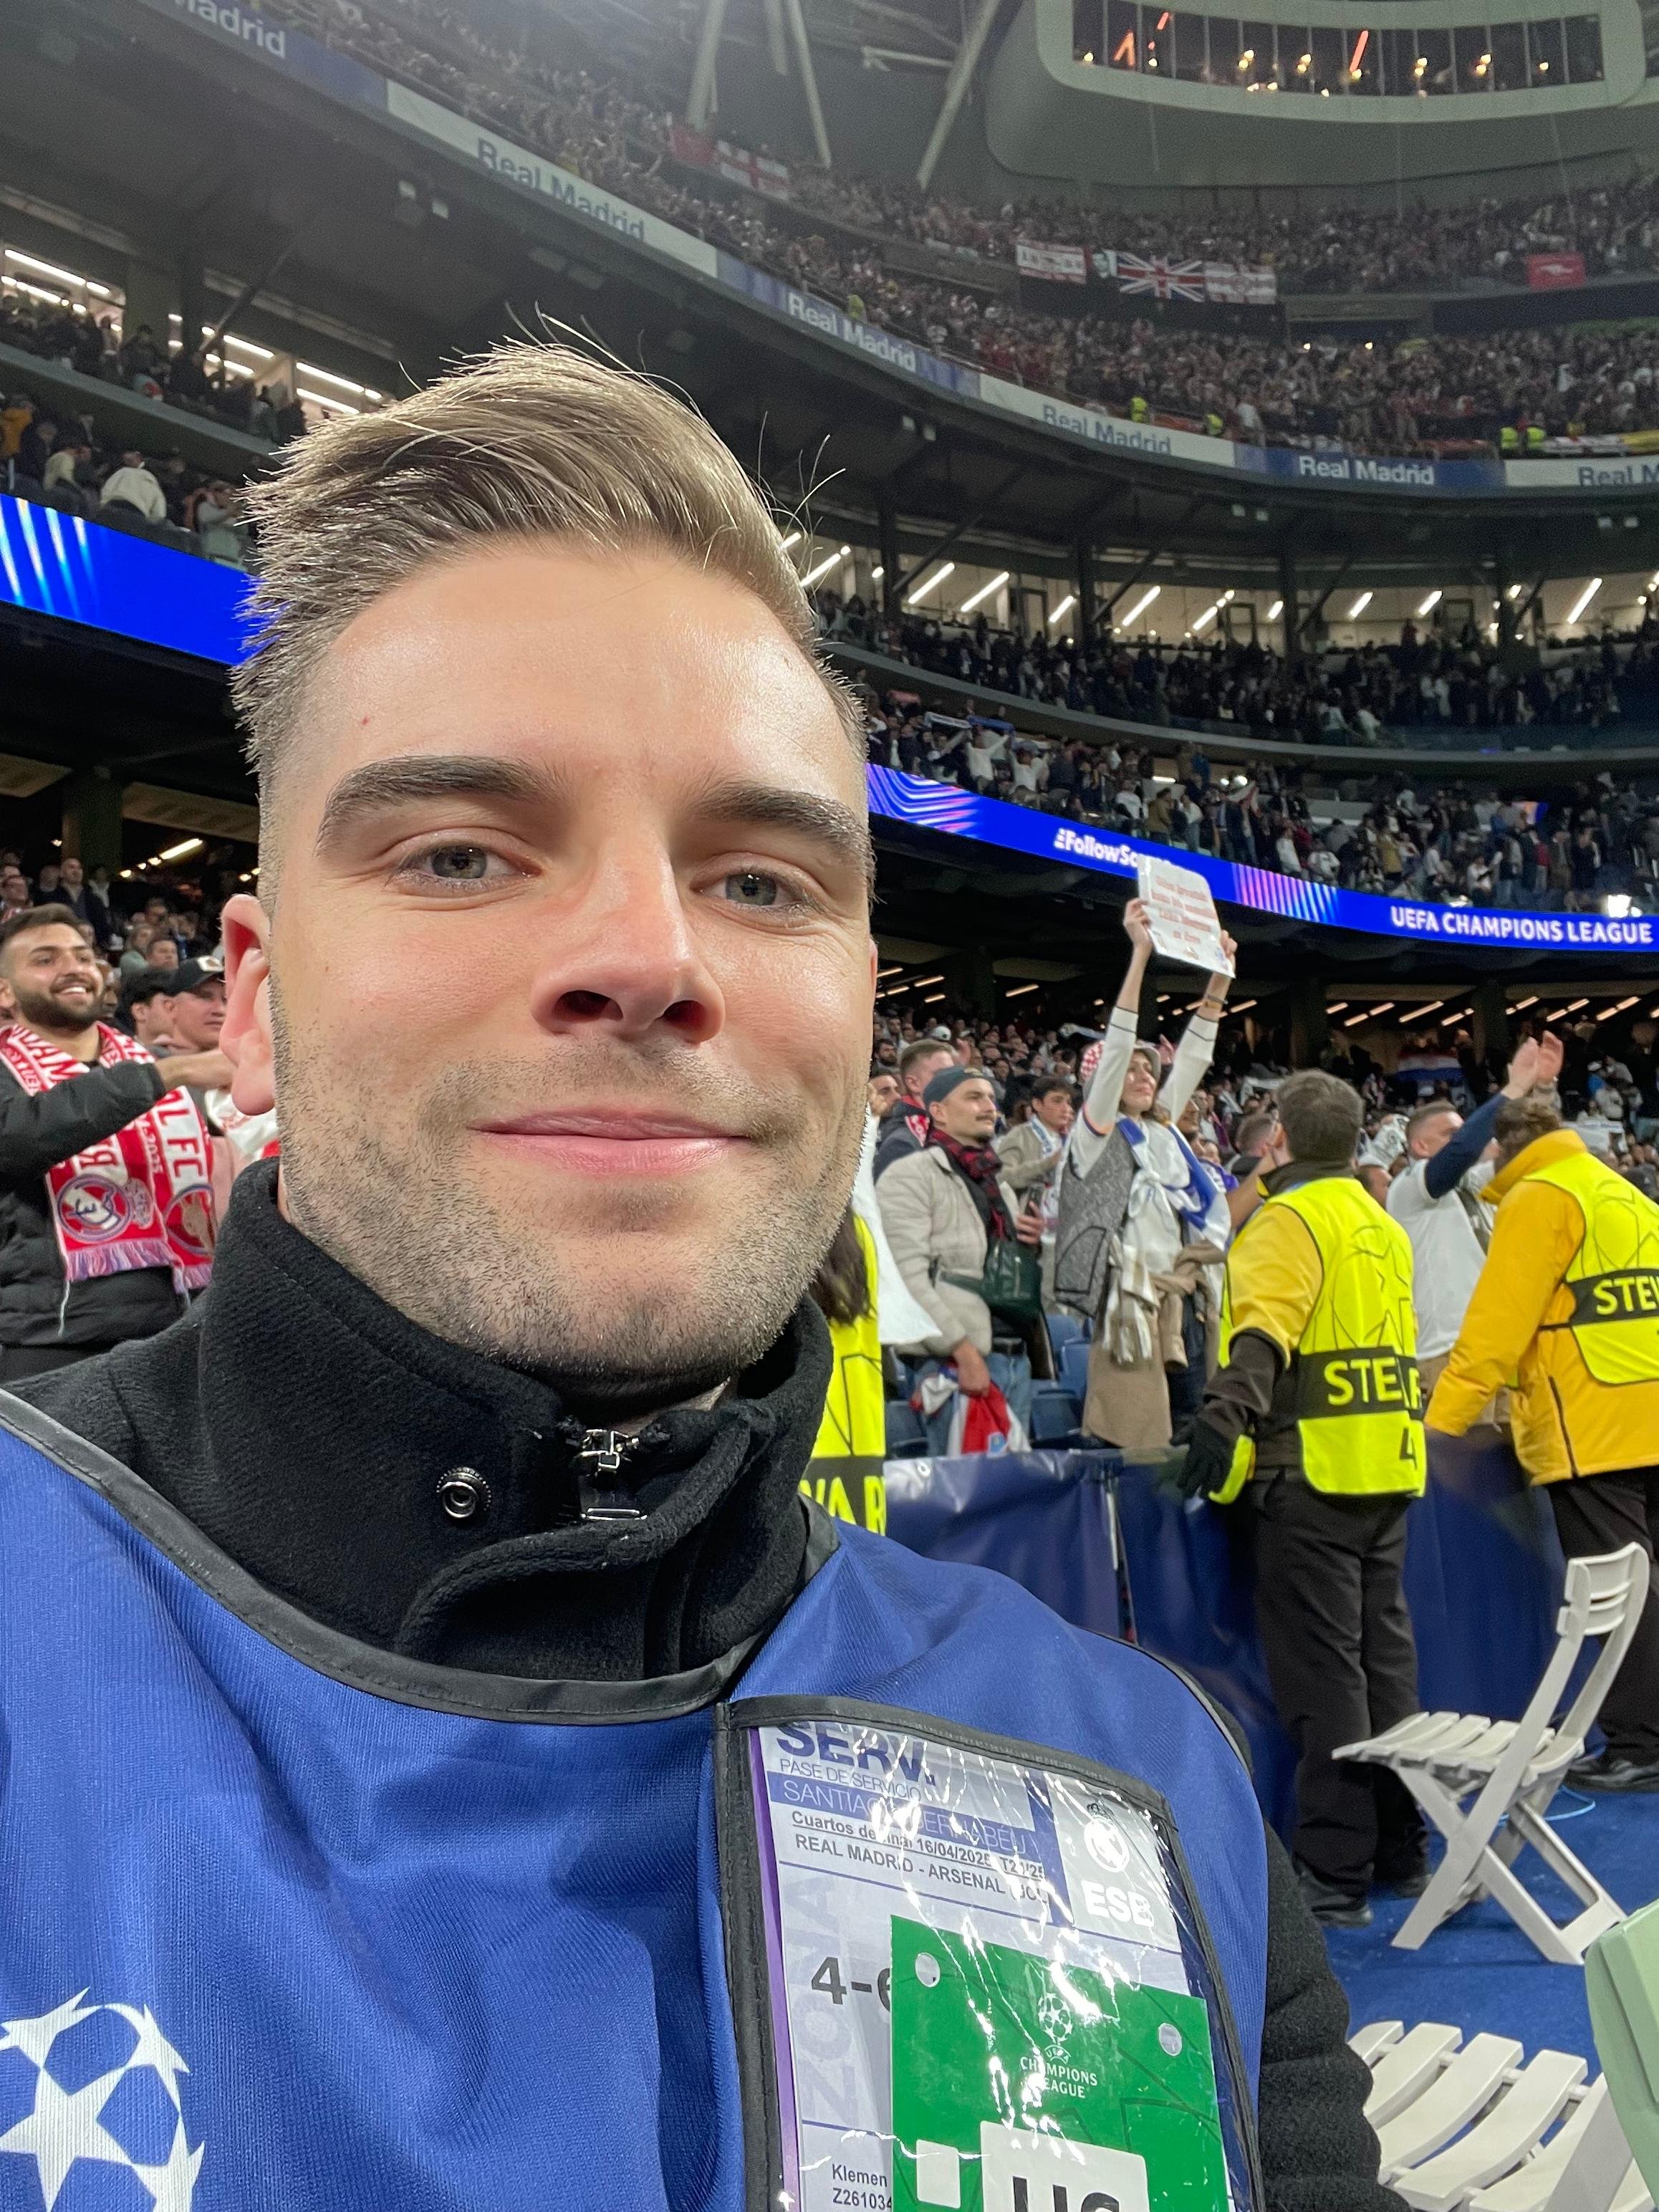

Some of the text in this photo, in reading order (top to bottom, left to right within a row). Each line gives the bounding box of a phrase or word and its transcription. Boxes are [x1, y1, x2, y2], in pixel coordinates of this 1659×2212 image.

[175, 0, 287, 58] adrid
[478, 138, 644, 239] Real Madrid
[789, 292, 916, 373] Real Madrid
[1044, 404, 1172, 456] Real Madrid
[1299, 455, 1434, 485] Real Madrid
[1578, 465, 1633, 486] Real
[1390, 906, 1654, 944] UEFA CHAMPIONS LEAGUE
[167, 1137, 204, 1178] FC
[776, 1721, 936, 1787] SERV.
[780, 1759, 921, 1801] PASE DE SERVICIO
[784, 1780, 883, 1820] SANTIA
[792, 1811, 854, 1835] Cuartos
[859, 1825, 876, 1840] de
[796, 1834, 843, 1857] REAL
[847, 1844, 913, 1872] MADRID
[929, 1864, 1006, 1894] ARSENAL
[1020, 2057, 1098, 2087] CHMPIONS
[1037, 2077, 1086, 2099] EAGUE
[832, 2164, 888, 2188] Klemen
